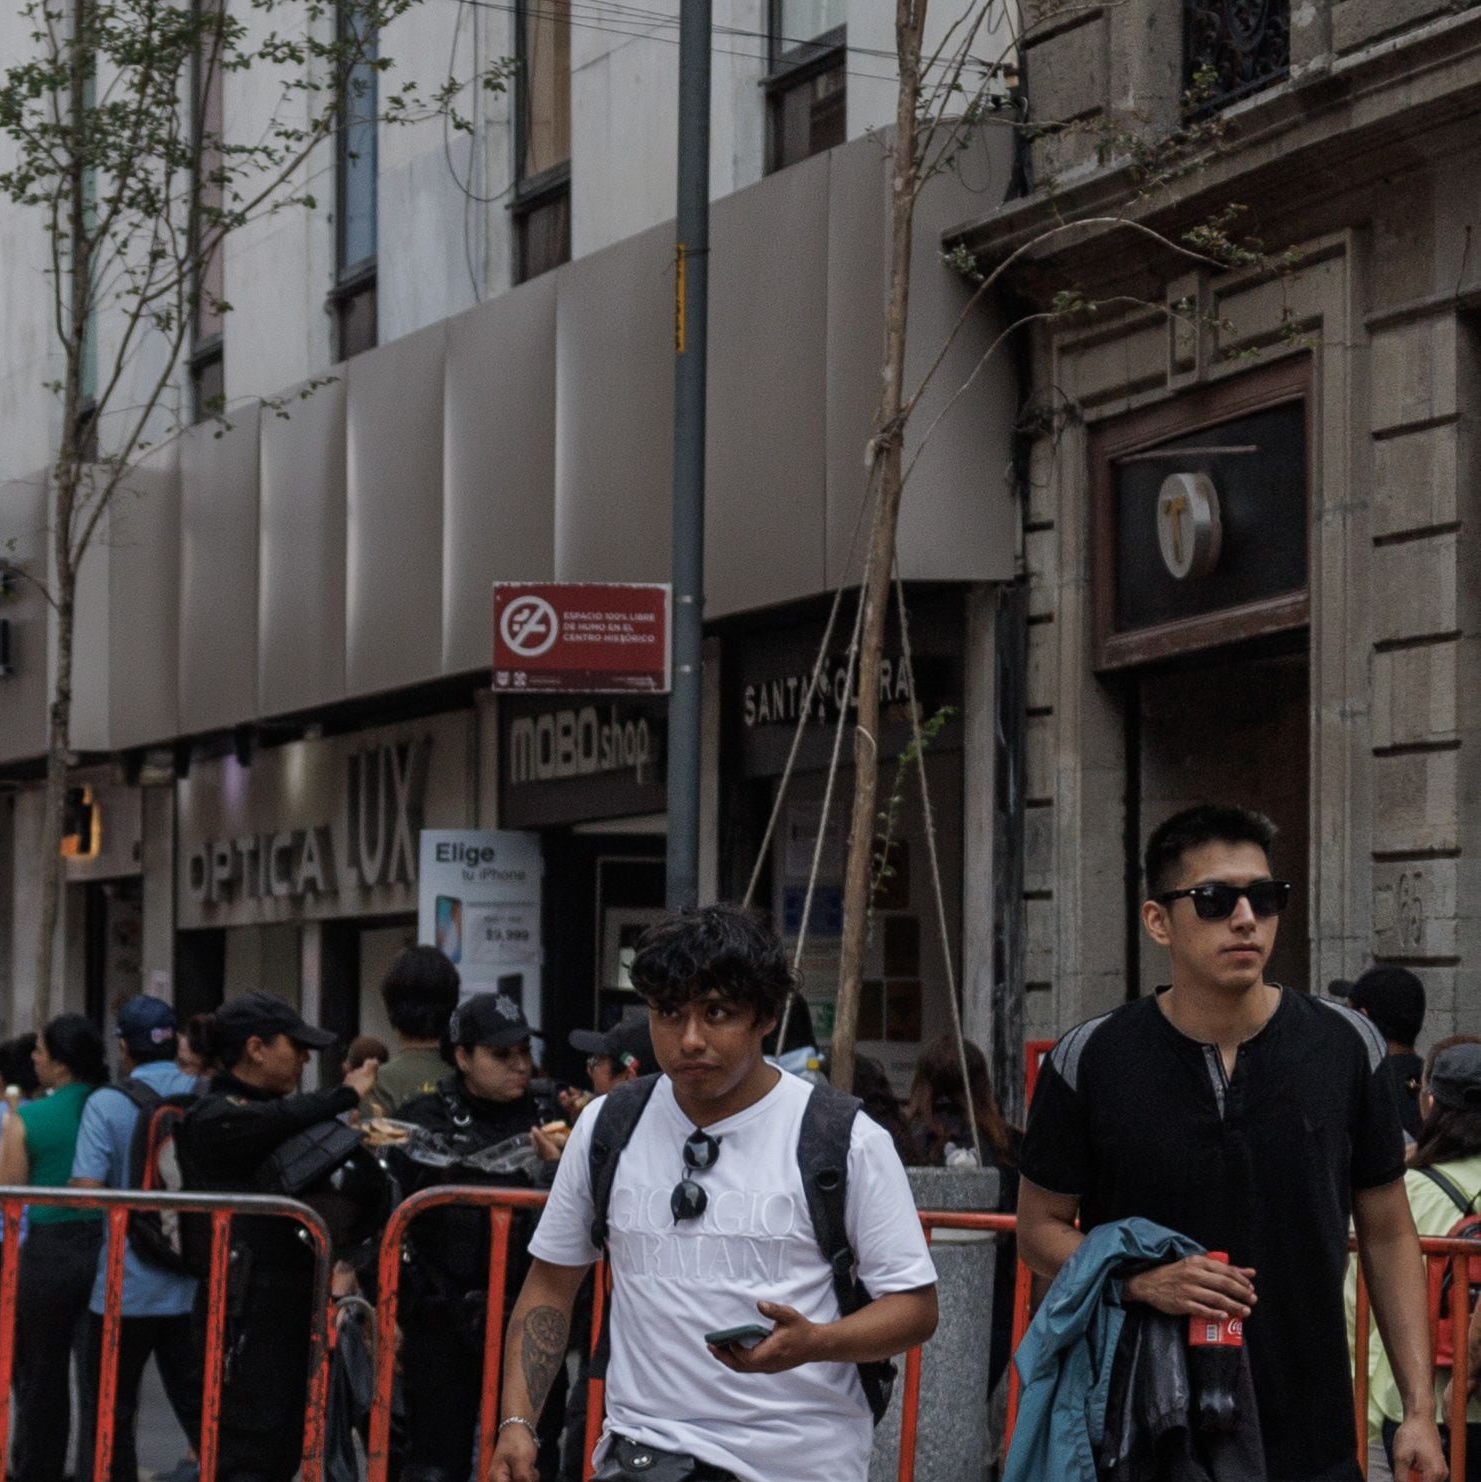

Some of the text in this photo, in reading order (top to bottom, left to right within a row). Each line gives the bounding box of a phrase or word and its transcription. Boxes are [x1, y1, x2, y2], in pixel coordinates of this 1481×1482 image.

[563, 612, 603, 621] ESPACIO
[629, 613, 655, 621] LIBRE
[623, 624, 634, 632] EL
[563, 633, 601, 642] CENTRO
[744, 676, 813, 727] SANTA
[341, 744, 419, 893] LUX
[435, 842, 495, 868] Elige
[613, 1185, 795, 1235] GIOGIO
[620, 1234, 789, 1285] ARMANI
